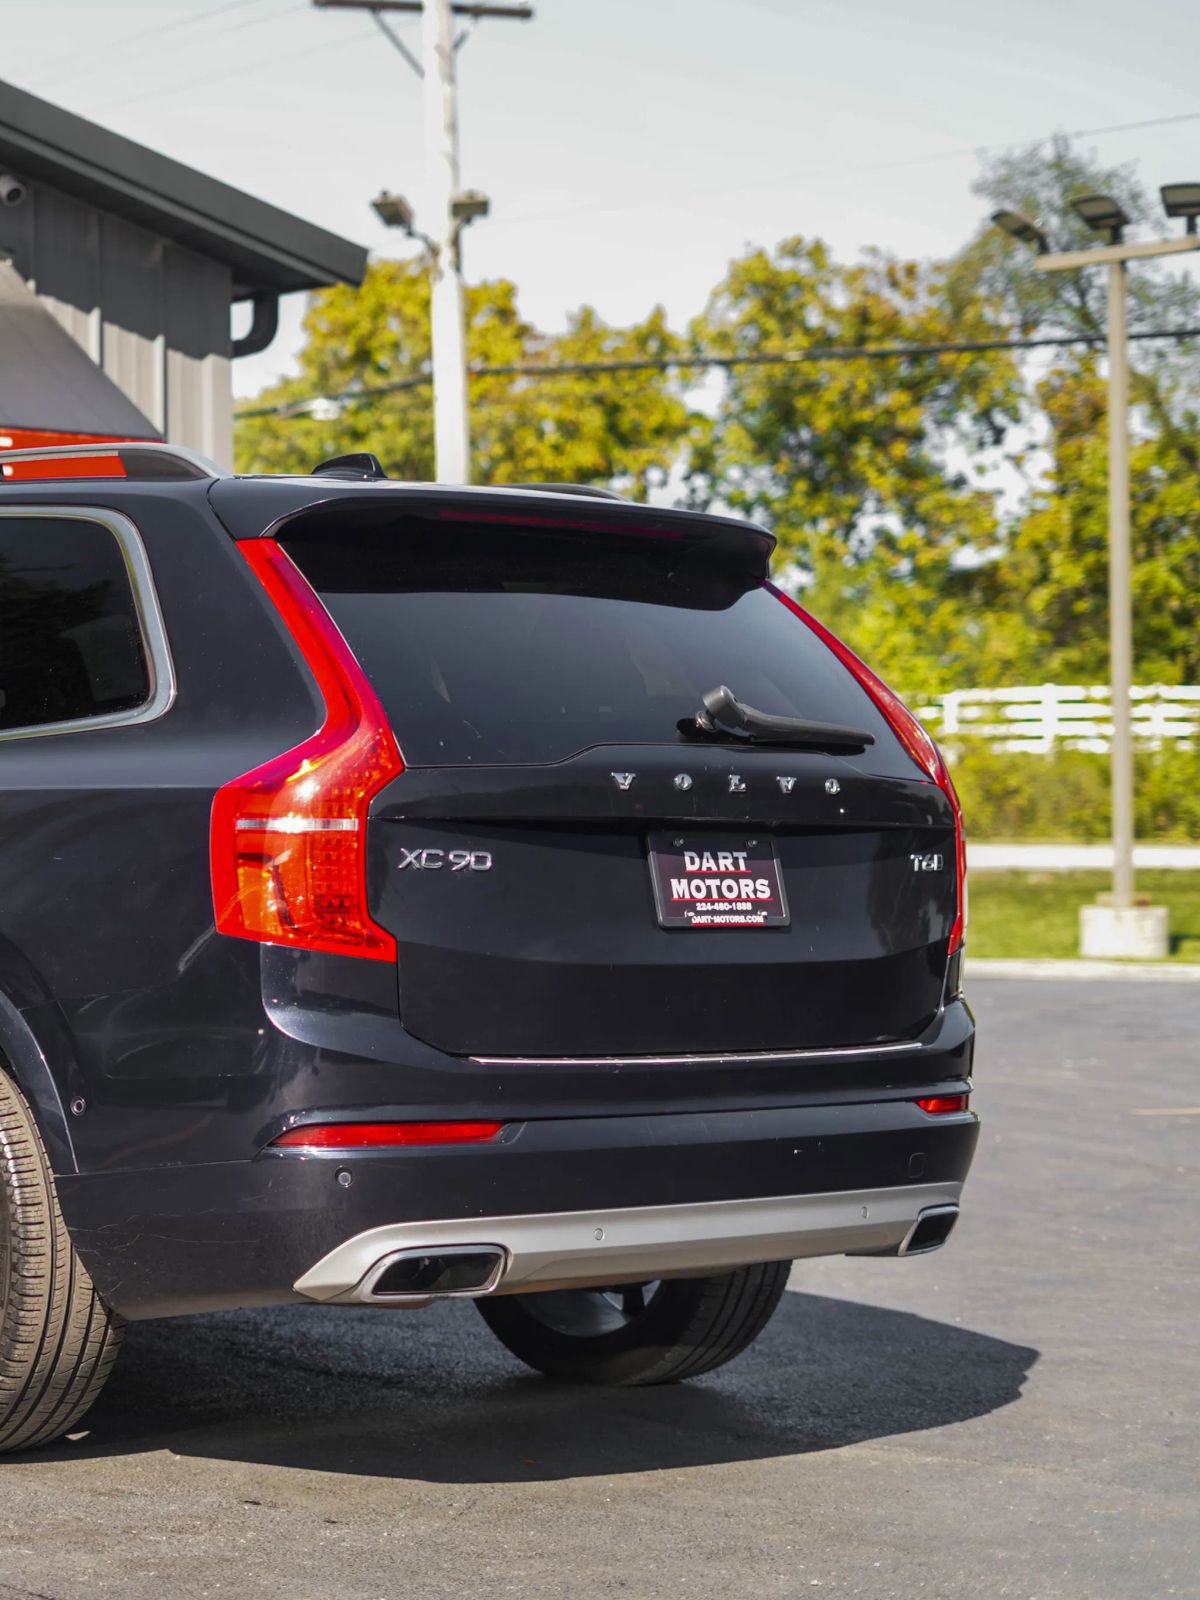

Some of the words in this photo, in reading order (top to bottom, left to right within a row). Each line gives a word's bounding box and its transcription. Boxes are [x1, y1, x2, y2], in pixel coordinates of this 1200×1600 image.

[611, 772, 841, 796] VOLVO
[684, 851, 747, 871] DART
[670, 878, 771, 899] MOTORS
